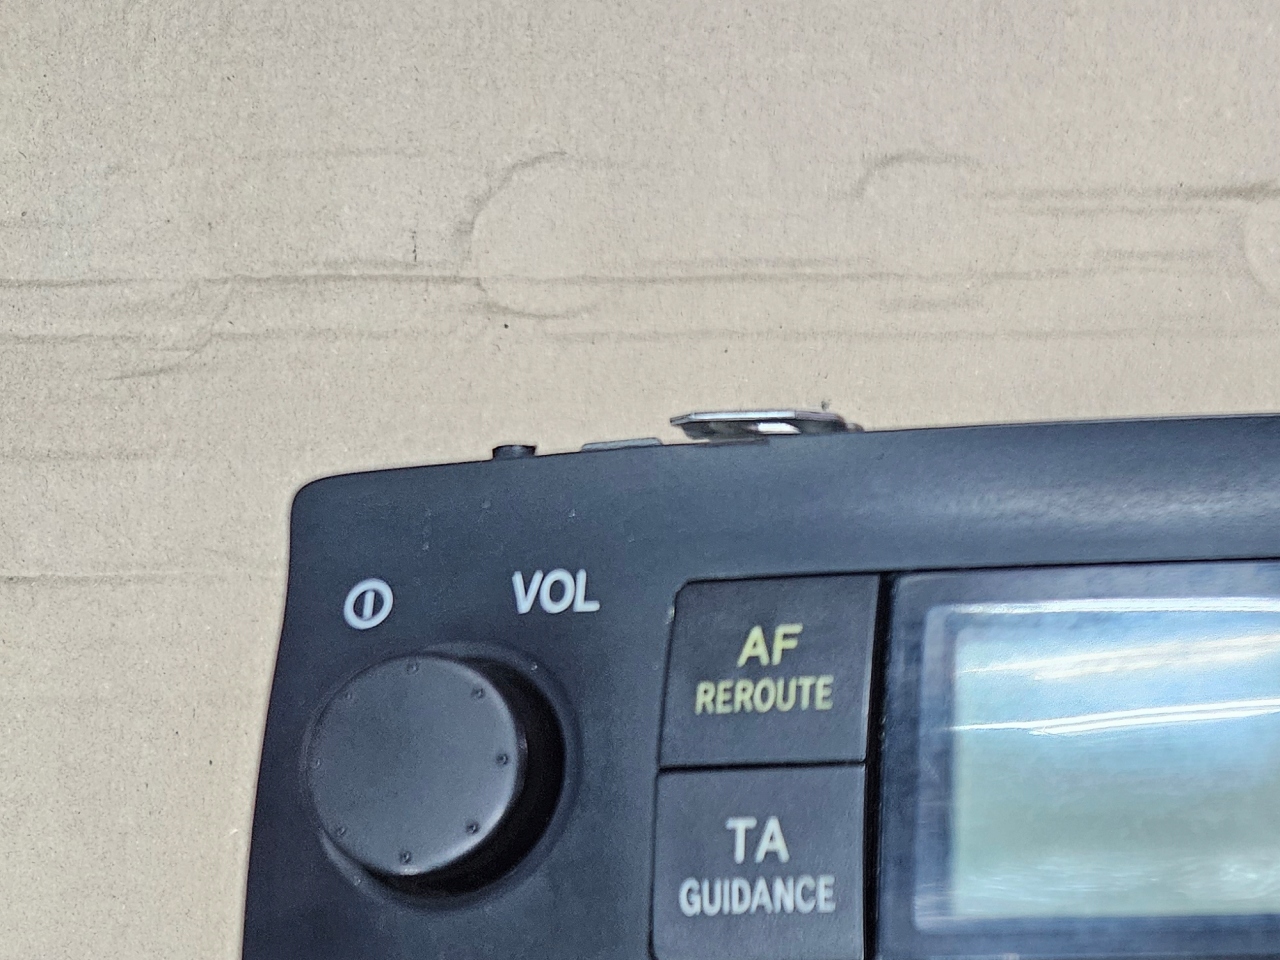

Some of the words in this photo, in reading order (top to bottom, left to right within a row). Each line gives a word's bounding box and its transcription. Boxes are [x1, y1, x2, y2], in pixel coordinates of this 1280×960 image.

[512, 568, 601, 614] VOL
[738, 623, 804, 667] AF
[694, 675, 834, 715] REROUTE
[725, 816, 790, 864] TA
[678, 874, 836, 915] GUIDANCE
